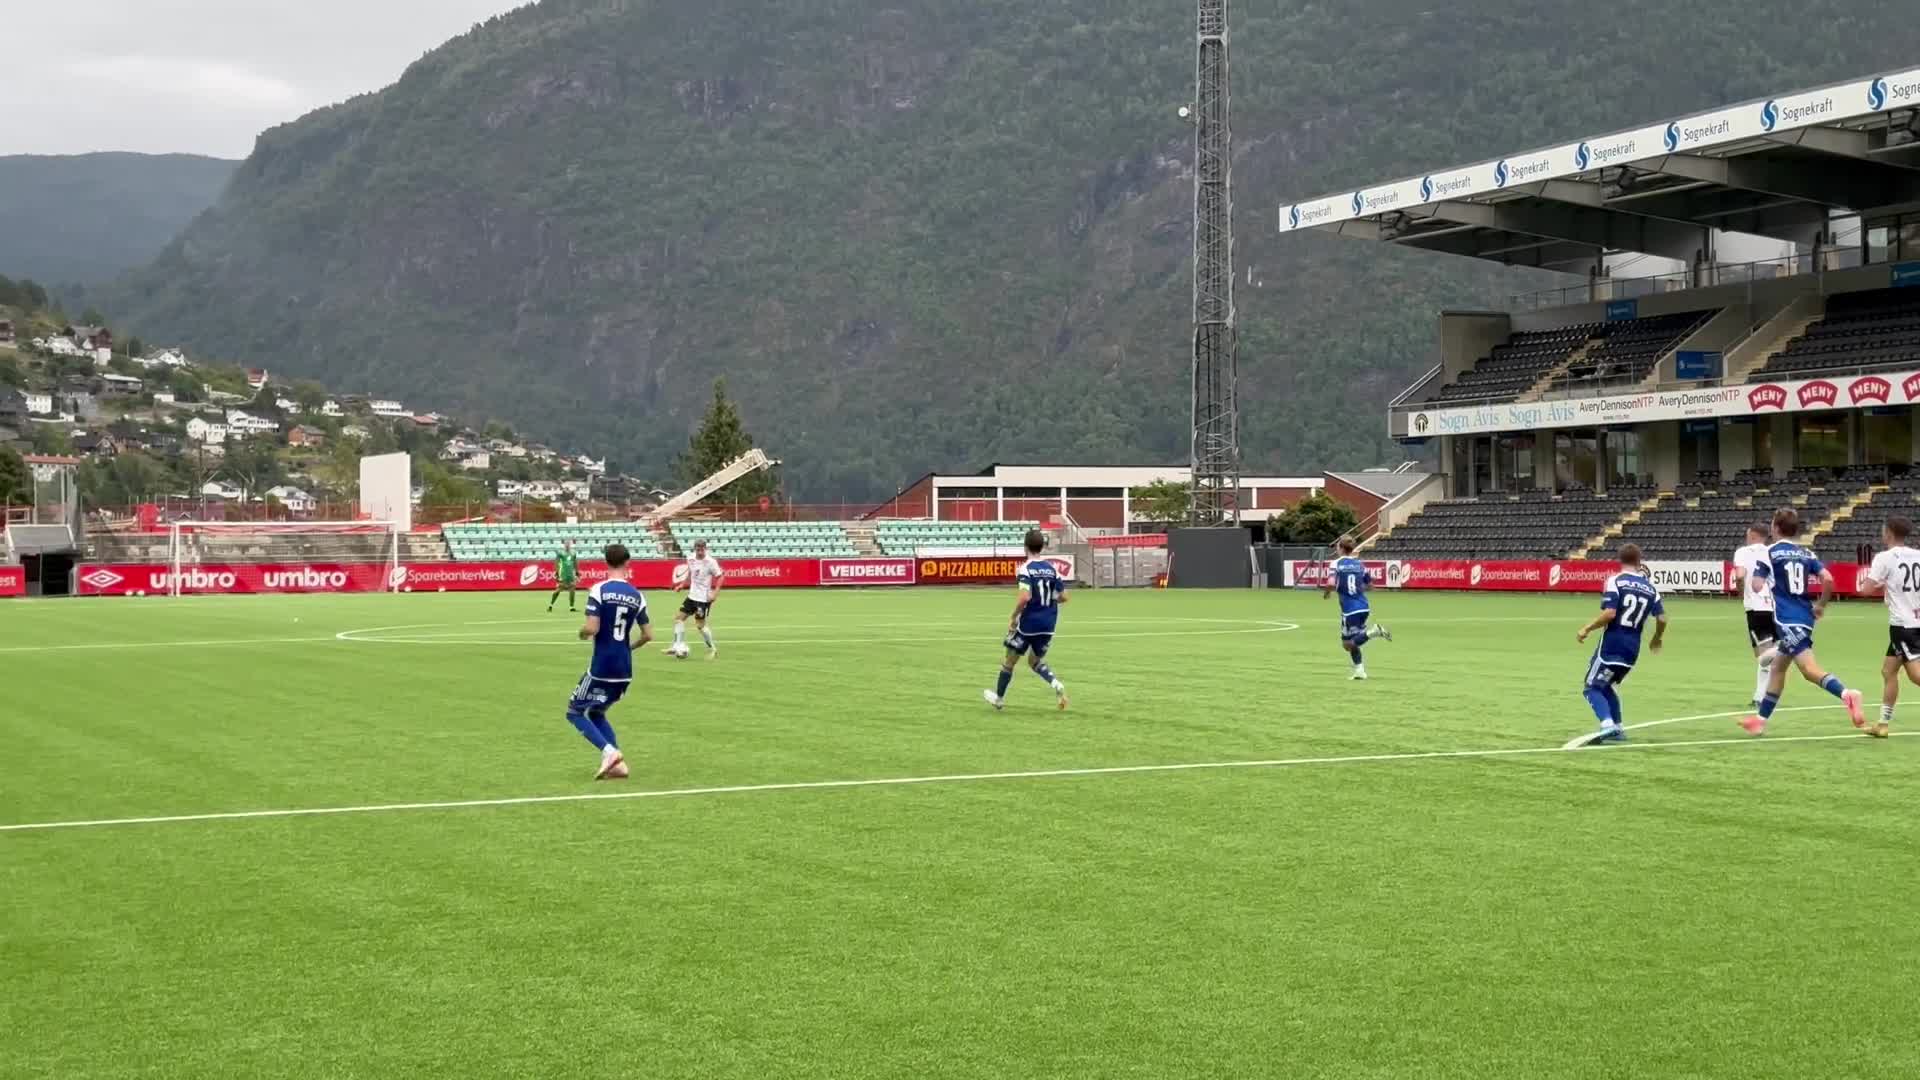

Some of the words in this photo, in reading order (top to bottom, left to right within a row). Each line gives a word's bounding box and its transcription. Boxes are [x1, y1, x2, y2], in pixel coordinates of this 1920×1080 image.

[1783, 99, 1832, 121] Sognekraft
[1684, 120, 1729, 142] Sognekraft
[1593, 142, 1635, 161] Sognekraft
[1511, 160, 1549, 179] Sognekraft
[1436, 176, 1471, 194] Sognekraft
[1366, 192, 1398, 209] Sognekraft
[1752, 389, 1783, 405] MENY
[1802, 386, 1834, 402] MENY
[1853, 381, 1887, 398] MENY
[1440, 411, 1469, 432] Sogn
[1473, 408, 1500, 427] Avis
[1509, 406, 1541, 427] Sogn
[1547, 402, 1575, 421] Avis
[150, 568, 236, 588] umbro
[264, 568, 347, 587] umbro
[408, 569, 506, 583] SparebankenVest
[829, 564, 906, 577] VEIDEKKE
[1410, 567, 1465, 580] SparebankenVest
[1481, 568, 1540, 582] SparebankenVest
[1684, 570, 1698, 584] NO
[1784, 561, 1805, 595] 19
[1898, 562, 1920, 592] 20
[1037, 579, 1051, 606] 11
[1347, 574, 1357, 596] 8
[1621, 593, 1649, 629] 27
[613, 606, 629, 641] 5
